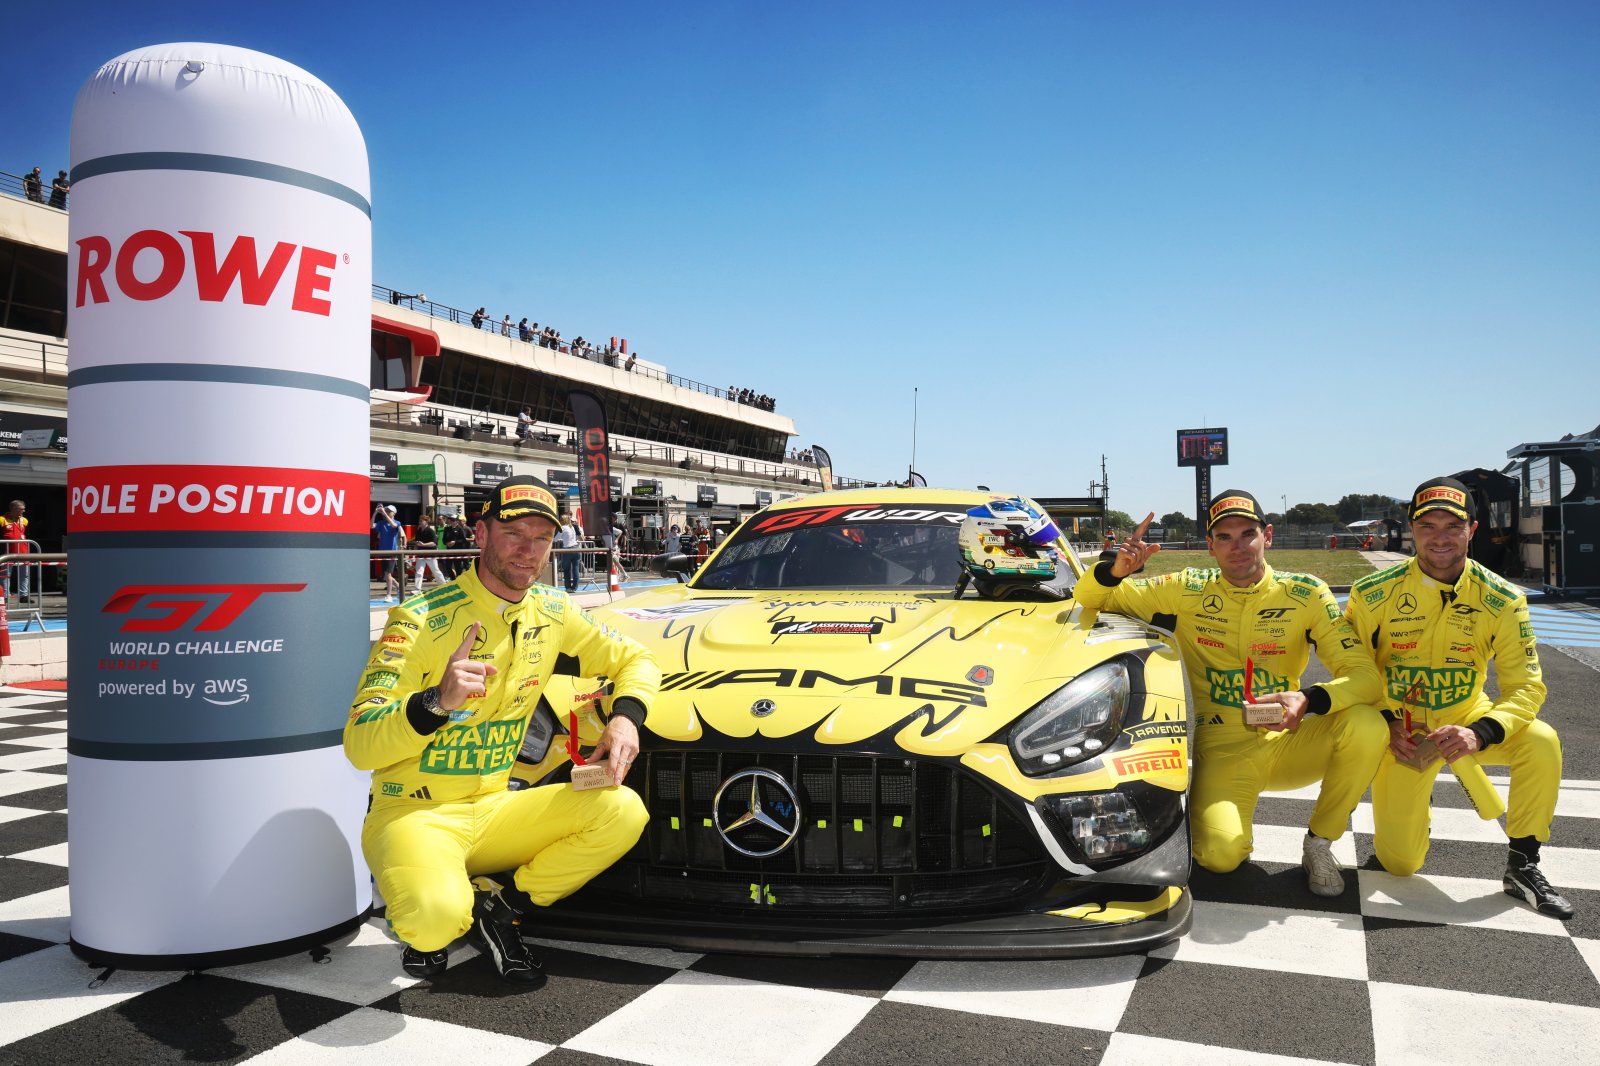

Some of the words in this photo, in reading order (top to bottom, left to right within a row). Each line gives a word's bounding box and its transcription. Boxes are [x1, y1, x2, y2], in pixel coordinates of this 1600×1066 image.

[76, 230, 337, 316] ROWE
[71, 484, 139, 515] POLE
[149, 483, 345, 517] POSITION
[842, 509, 969, 525] WOR
[1291, 586, 1312, 597] OMP
[1365, 590, 1384, 603] OMP
[101, 583, 308, 633] GT
[1485, 594, 1505, 608] OMP
[428, 614, 448, 629] OMP
[109, 642, 170, 656] WORLD
[174, 639, 284, 655] CHALLENGE
[98, 659, 160, 671] EUROPE
[1391, 668, 1472, 688] MANN
[98, 679, 166, 698] powered
[172, 679, 196, 698] by
[696, 668, 988, 707] AMG
[1392, 683, 1471, 706] FILTER
[574, 691, 604, 702] ROWE
[434, 722, 522, 747] MANN
[1135, 724, 1186, 738] RAVENOL
[427, 745, 517, 770] FILTER
[1112, 749, 1183, 776] PIRELLI
[382, 784, 404, 795] OMP
[583, 780, 605, 788] AWARD
